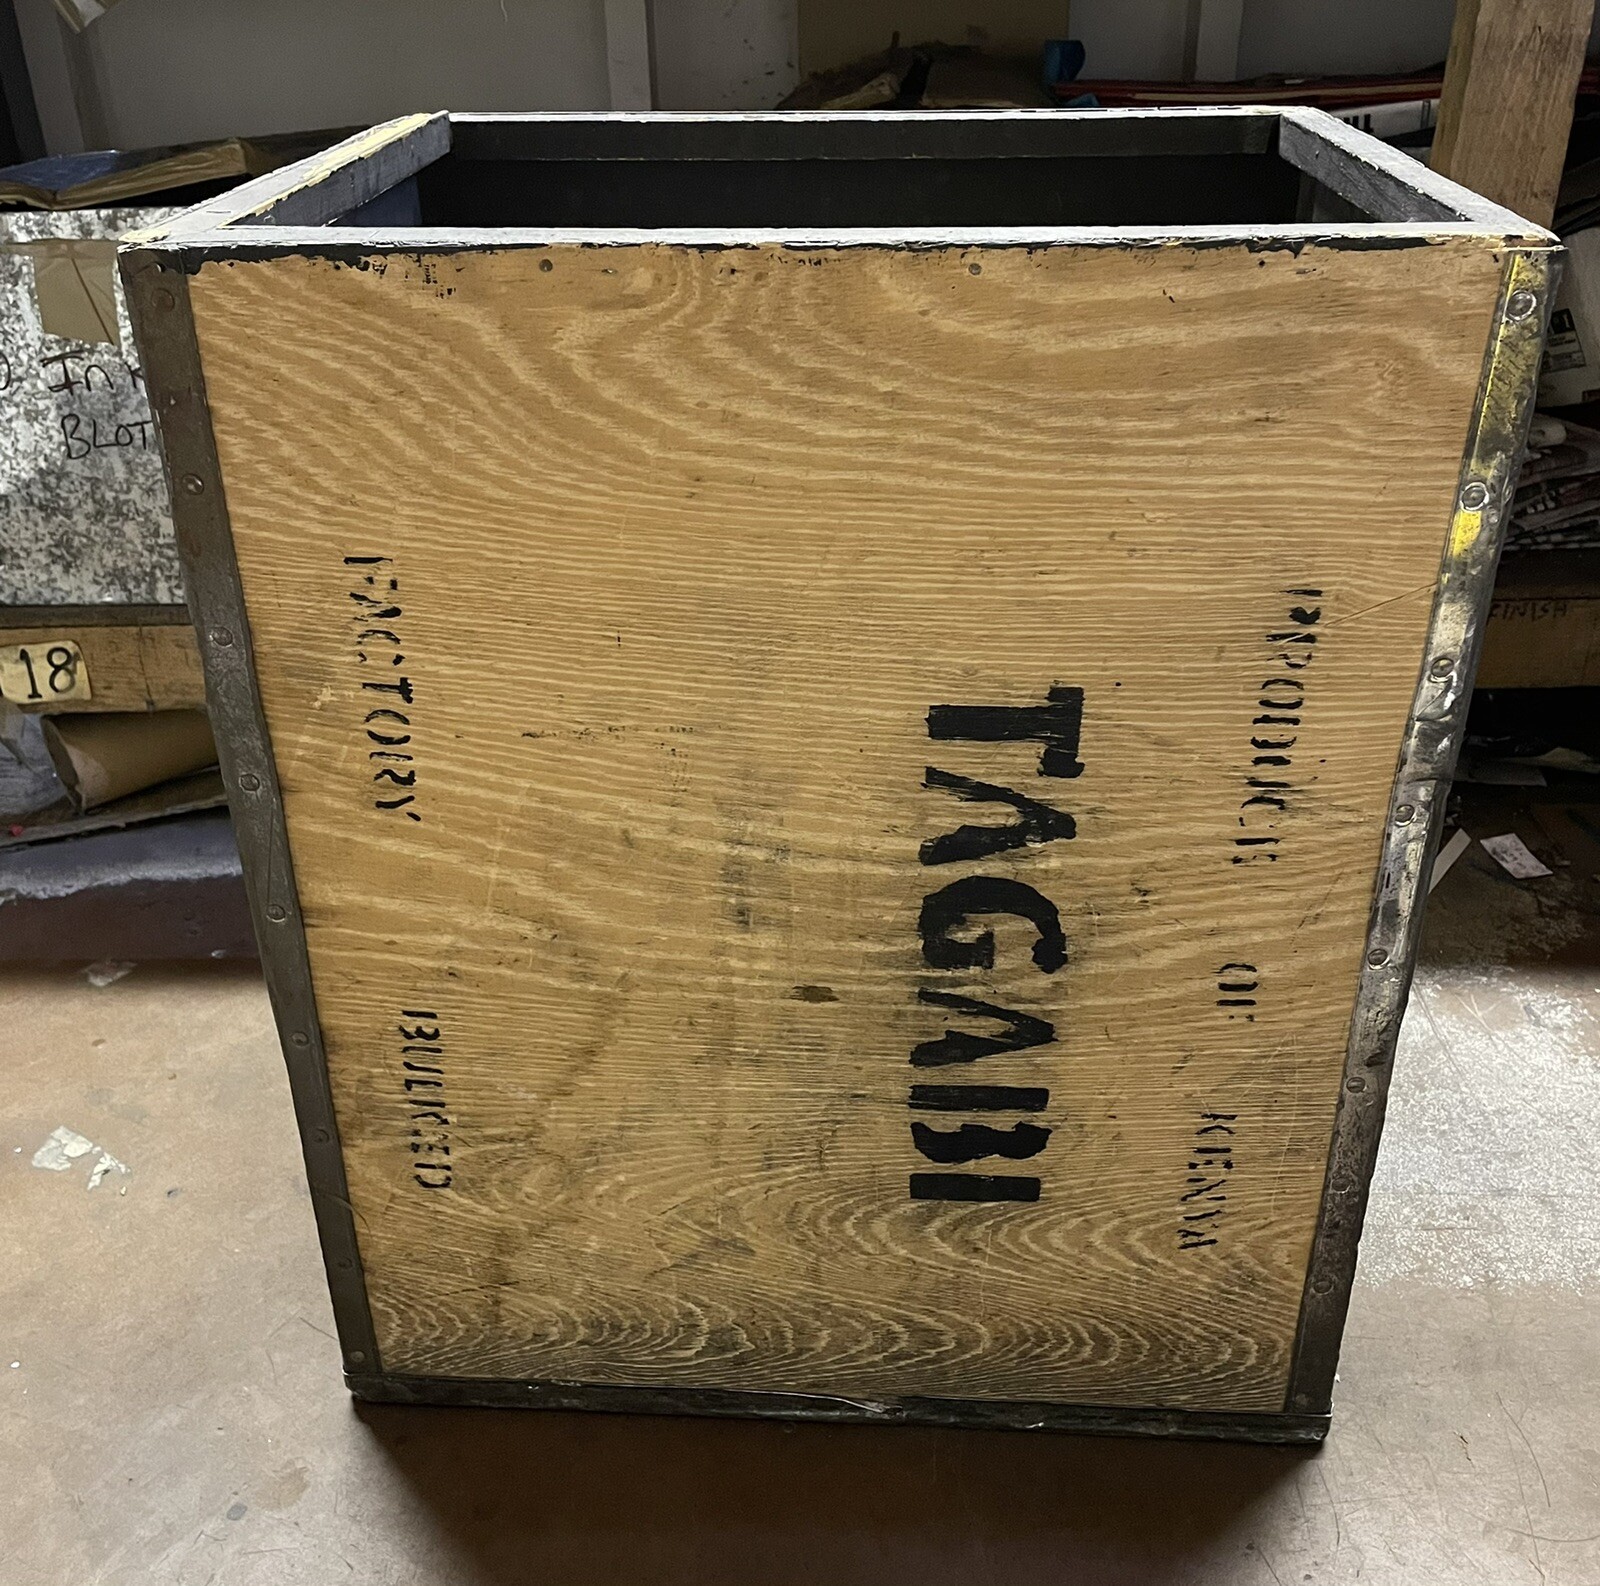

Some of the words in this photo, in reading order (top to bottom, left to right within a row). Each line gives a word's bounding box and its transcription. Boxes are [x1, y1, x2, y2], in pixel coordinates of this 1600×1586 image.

[60, 412, 152, 461] BLOT
[19, 645, 79, 700] 18
[1231, 588, 1324, 866] PRODUCE
[344, 556, 421, 821] FACTORY
[400, 1010, 452, 1190] BULKED
[908, 682, 1085, 1203] TAGABI
[1216, 962, 1260, 1023] OF
[1177, 1112, 1238, 1250] KENYA
